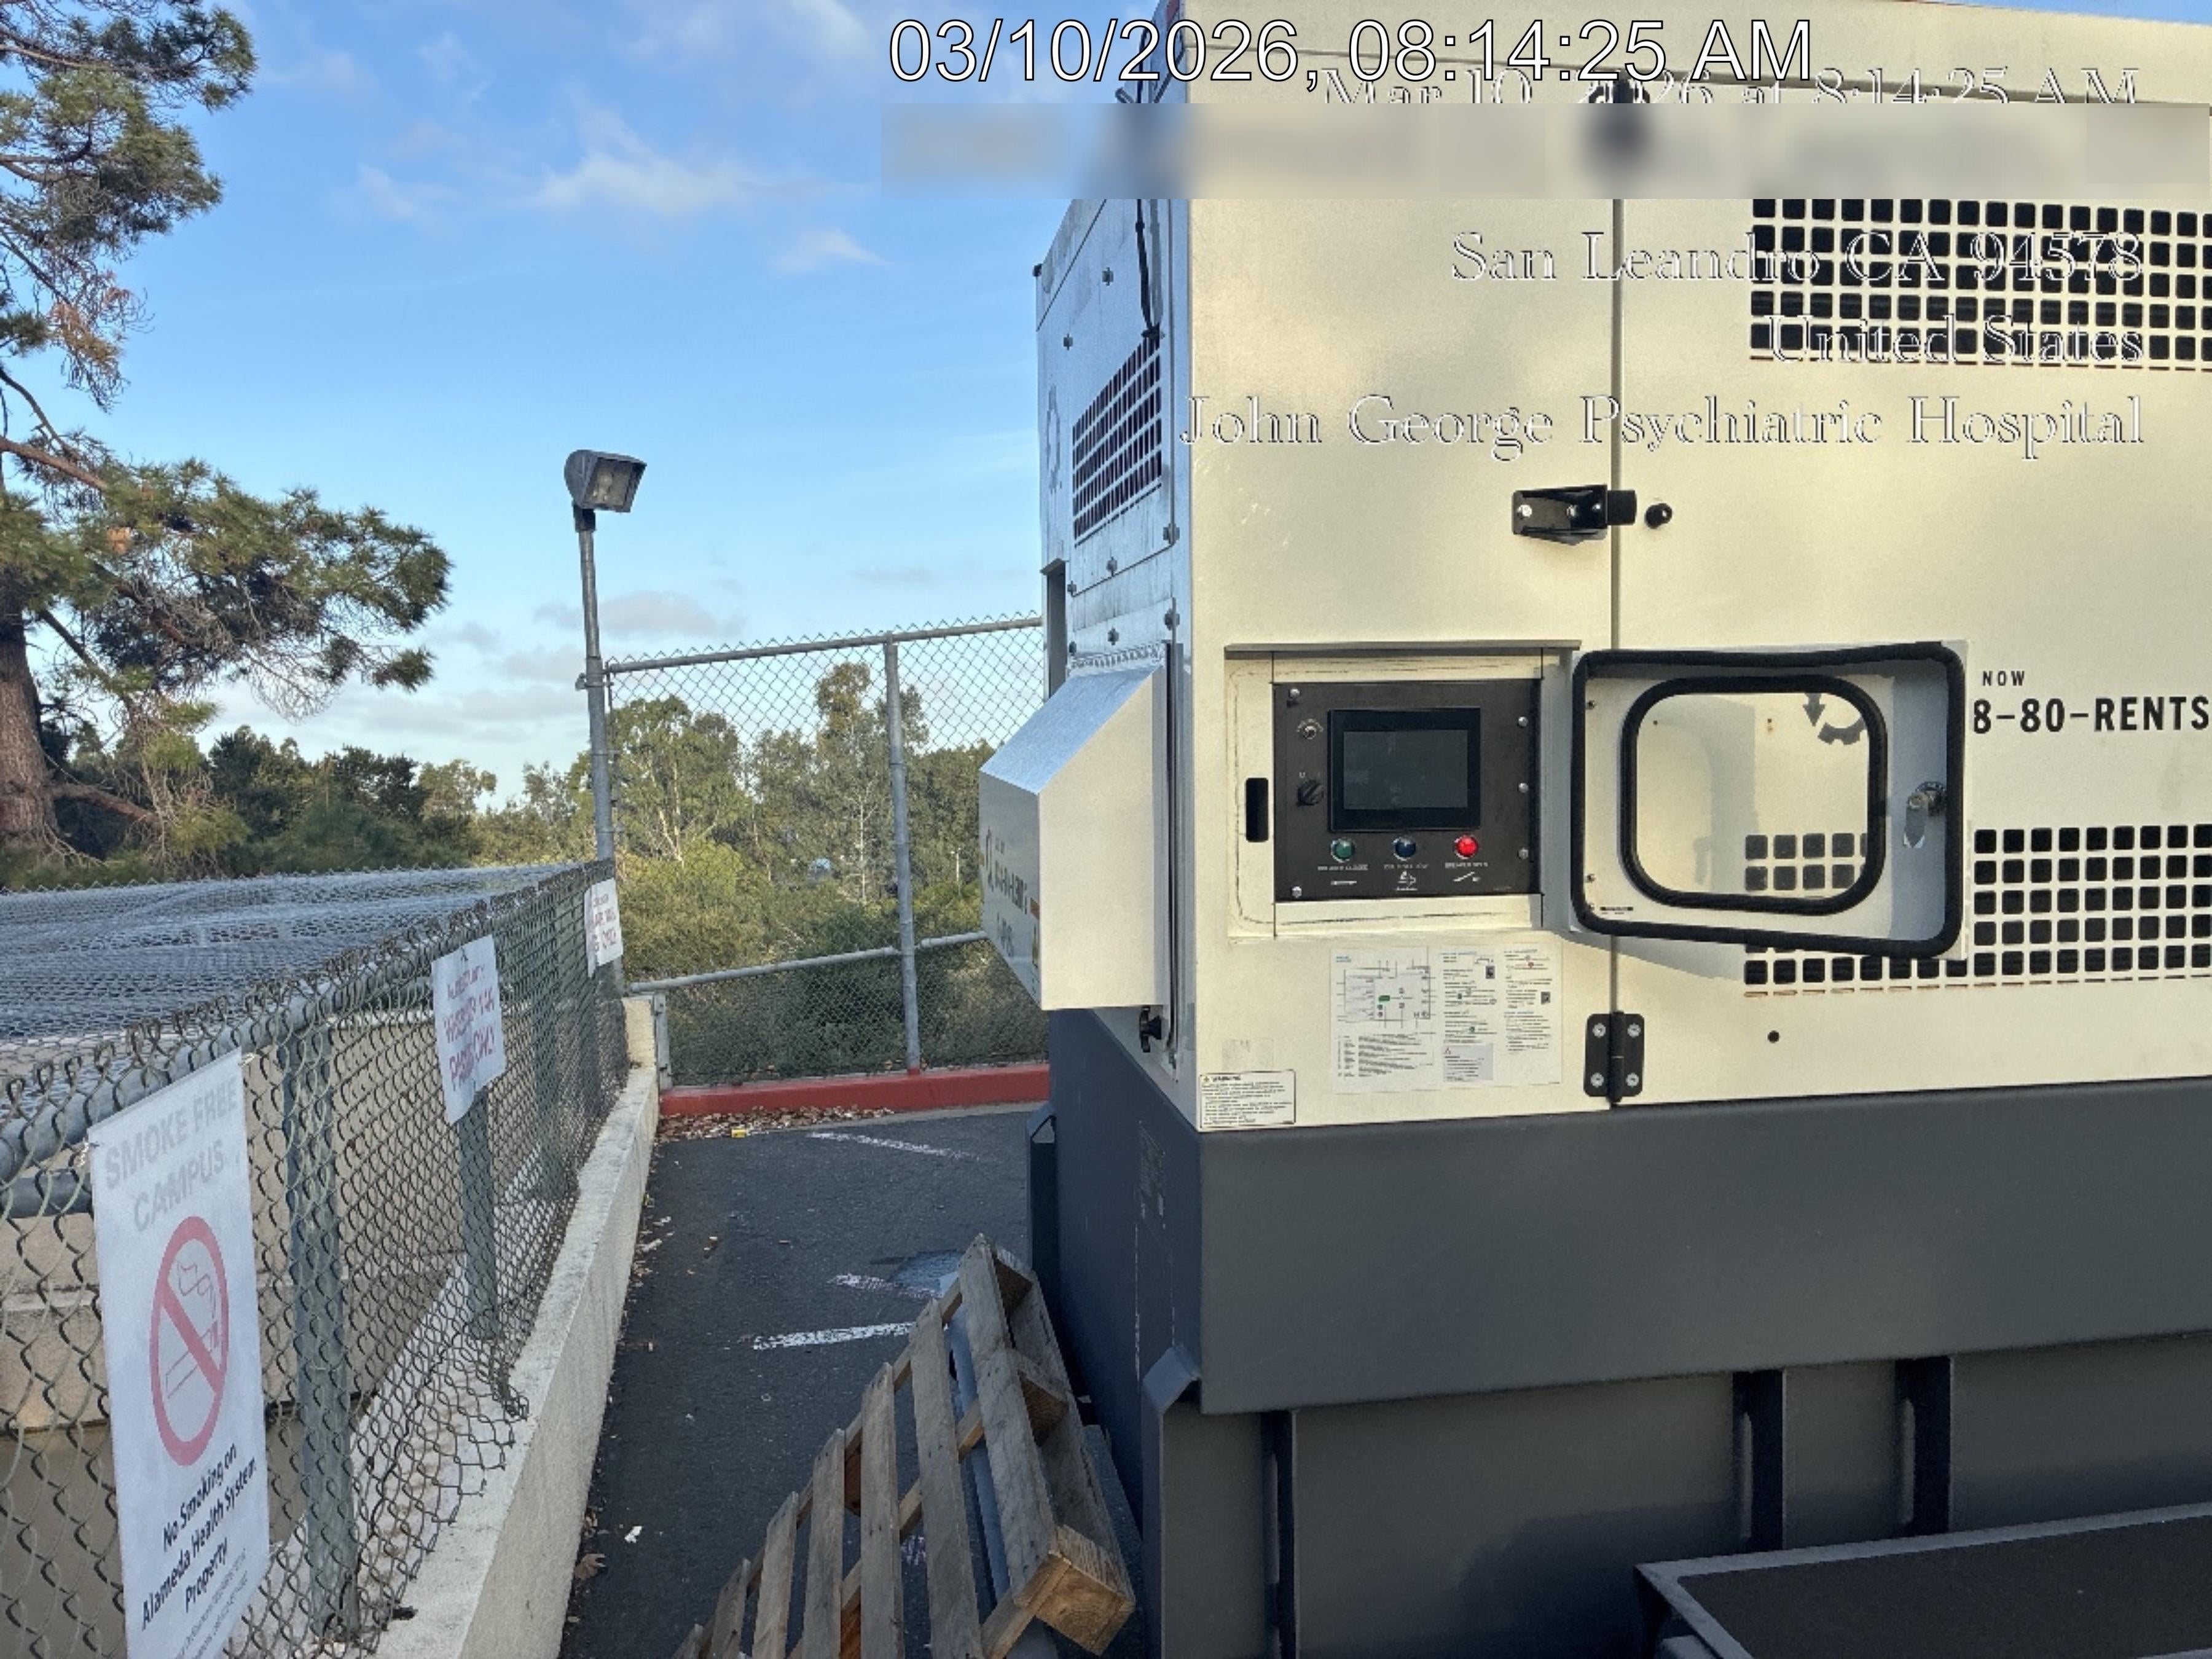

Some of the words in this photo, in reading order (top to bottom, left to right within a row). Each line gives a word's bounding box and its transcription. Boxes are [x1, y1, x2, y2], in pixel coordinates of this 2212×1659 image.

[1982, 670, 2025, 686] NOW
[105, 1106, 187, 1189] SMOKE
[192, 1078, 238, 1133] FREE
[134, 1139, 224, 1231] CAMPUS
[163, 1521, 179, 1552] No
[179, 1460, 223, 1531] Smoking
[224, 1443, 237, 1470] on
[142, 1547, 190, 1631] Alameda
[191, 1500, 224, 1559] Health
[184, 1537, 227, 1613] Property
